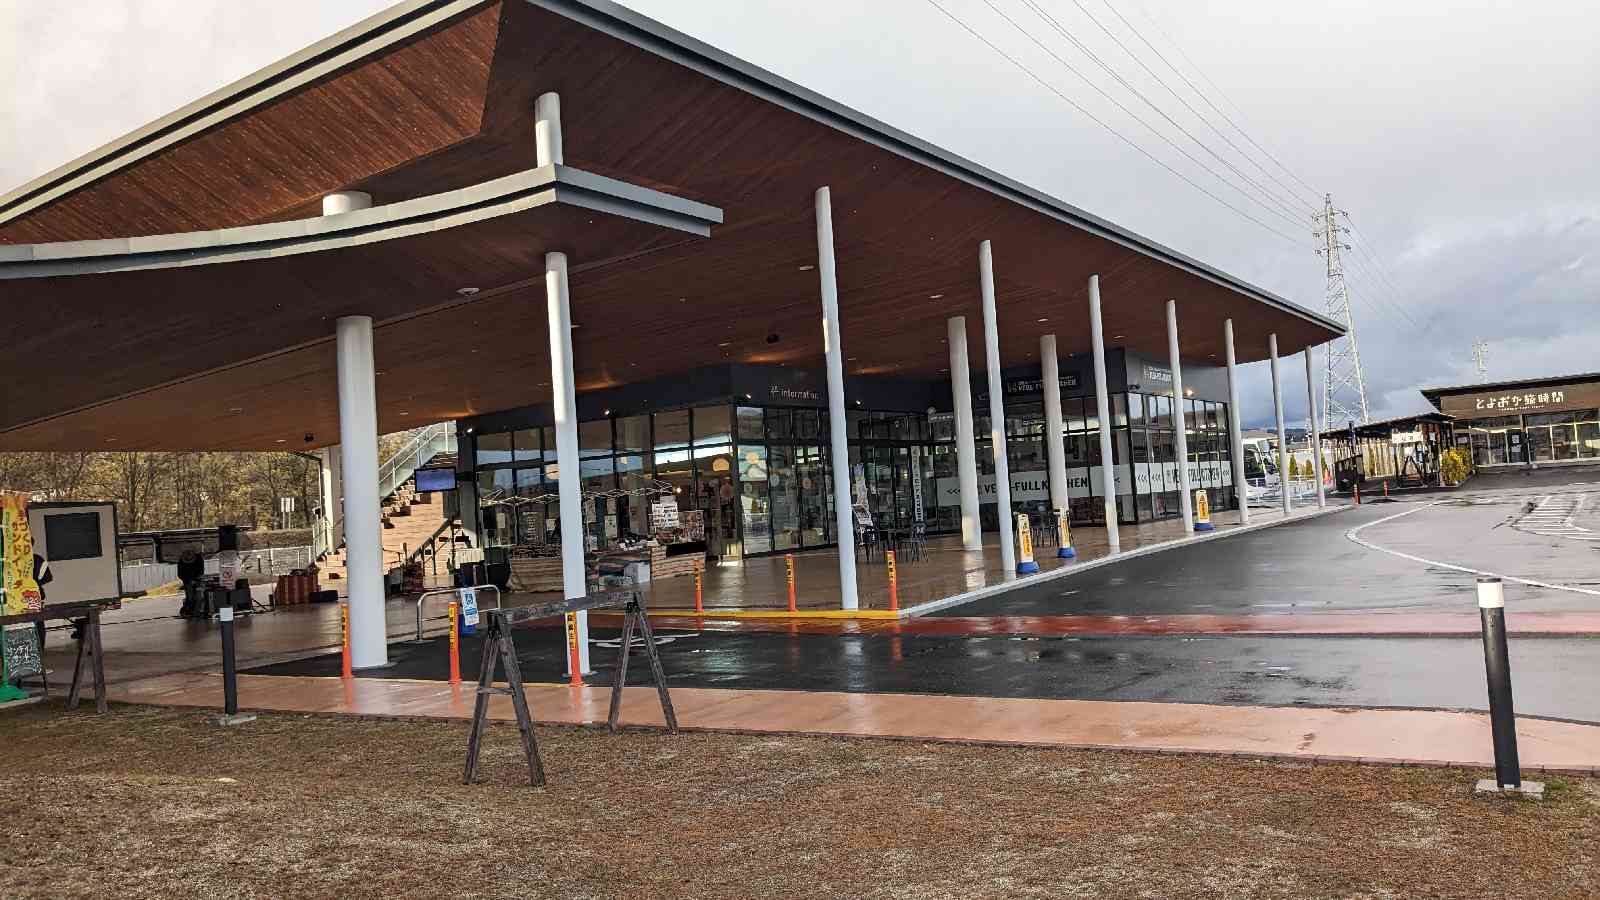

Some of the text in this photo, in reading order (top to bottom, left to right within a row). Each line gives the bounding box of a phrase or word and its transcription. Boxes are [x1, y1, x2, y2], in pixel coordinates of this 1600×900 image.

[1476, 391, 1564, 409] とよおか旅時間
